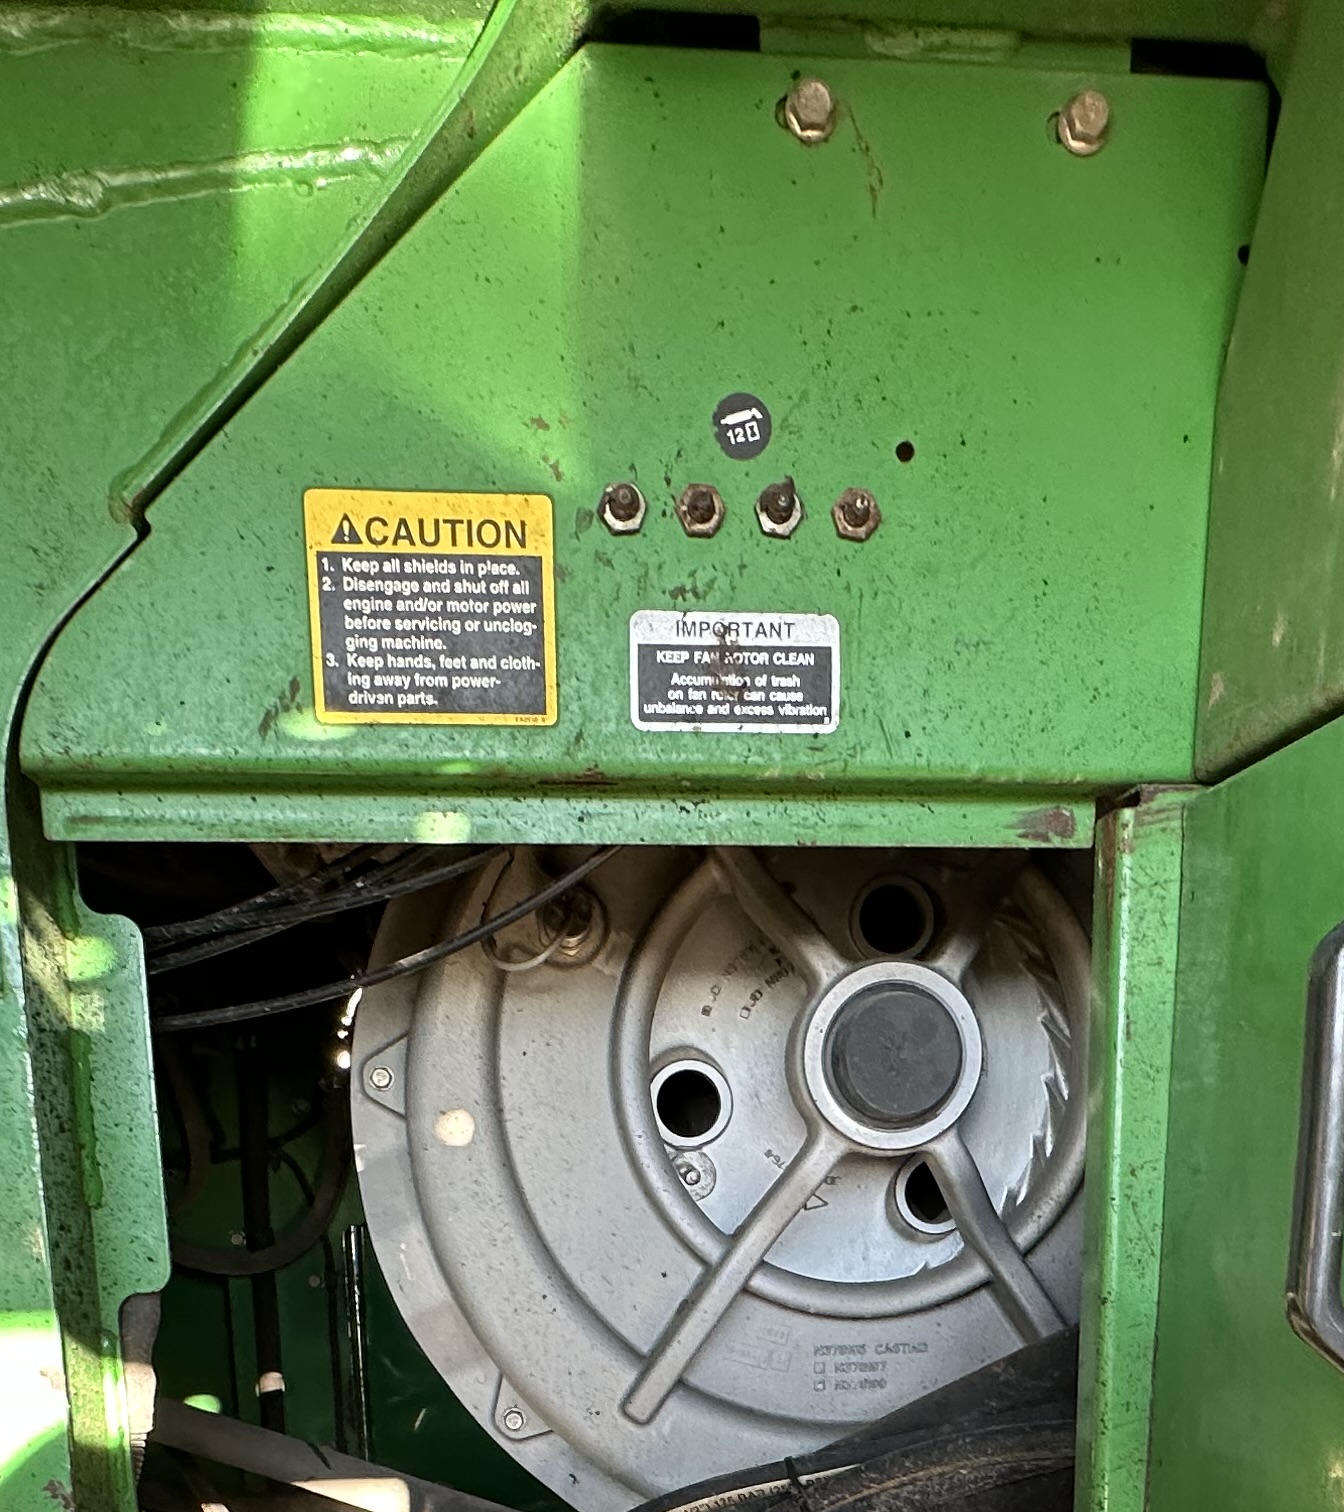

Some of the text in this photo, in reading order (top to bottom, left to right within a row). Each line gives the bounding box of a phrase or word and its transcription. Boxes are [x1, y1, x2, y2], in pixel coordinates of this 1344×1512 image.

[726, 427, 746, 445] 12
[364, 516, 527, 549] CAUTION
[321, 558, 520, 578] 1. Keep all shields in place.
[322, 577, 529, 595] 2. Disengage and shut off all
[343, 597, 537, 616] engine and/or motor power
[345, 615, 537, 636] before servicing or unclog-
[676, 621, 795, 638] IMPORTANT
[345, 634, 446, 652] ging machine.
[326, 653, 540, 670] 3. Keep hands, feet and cloth-
[657, 651, 689, 663] KEEP
[694, 651, 720, 664] FAN
[773, 652, 814, 666] CLEAN
[348, 672, 501, 690] ing away from power-
[755, 674, 768, 687] of
[771, 674, 800, 687] trash
[349, 691, 438, 708] driven parts.
[668, 690, 683, 700] on
[688, 688, 707, 700] fan
[744, 691, 765, 702] can
[769, 691, 804, 702] cause
[644, 702, 704, 715] unbalance
[707, 703, 730, 715] and
[734, 704, 774, 716] excess
